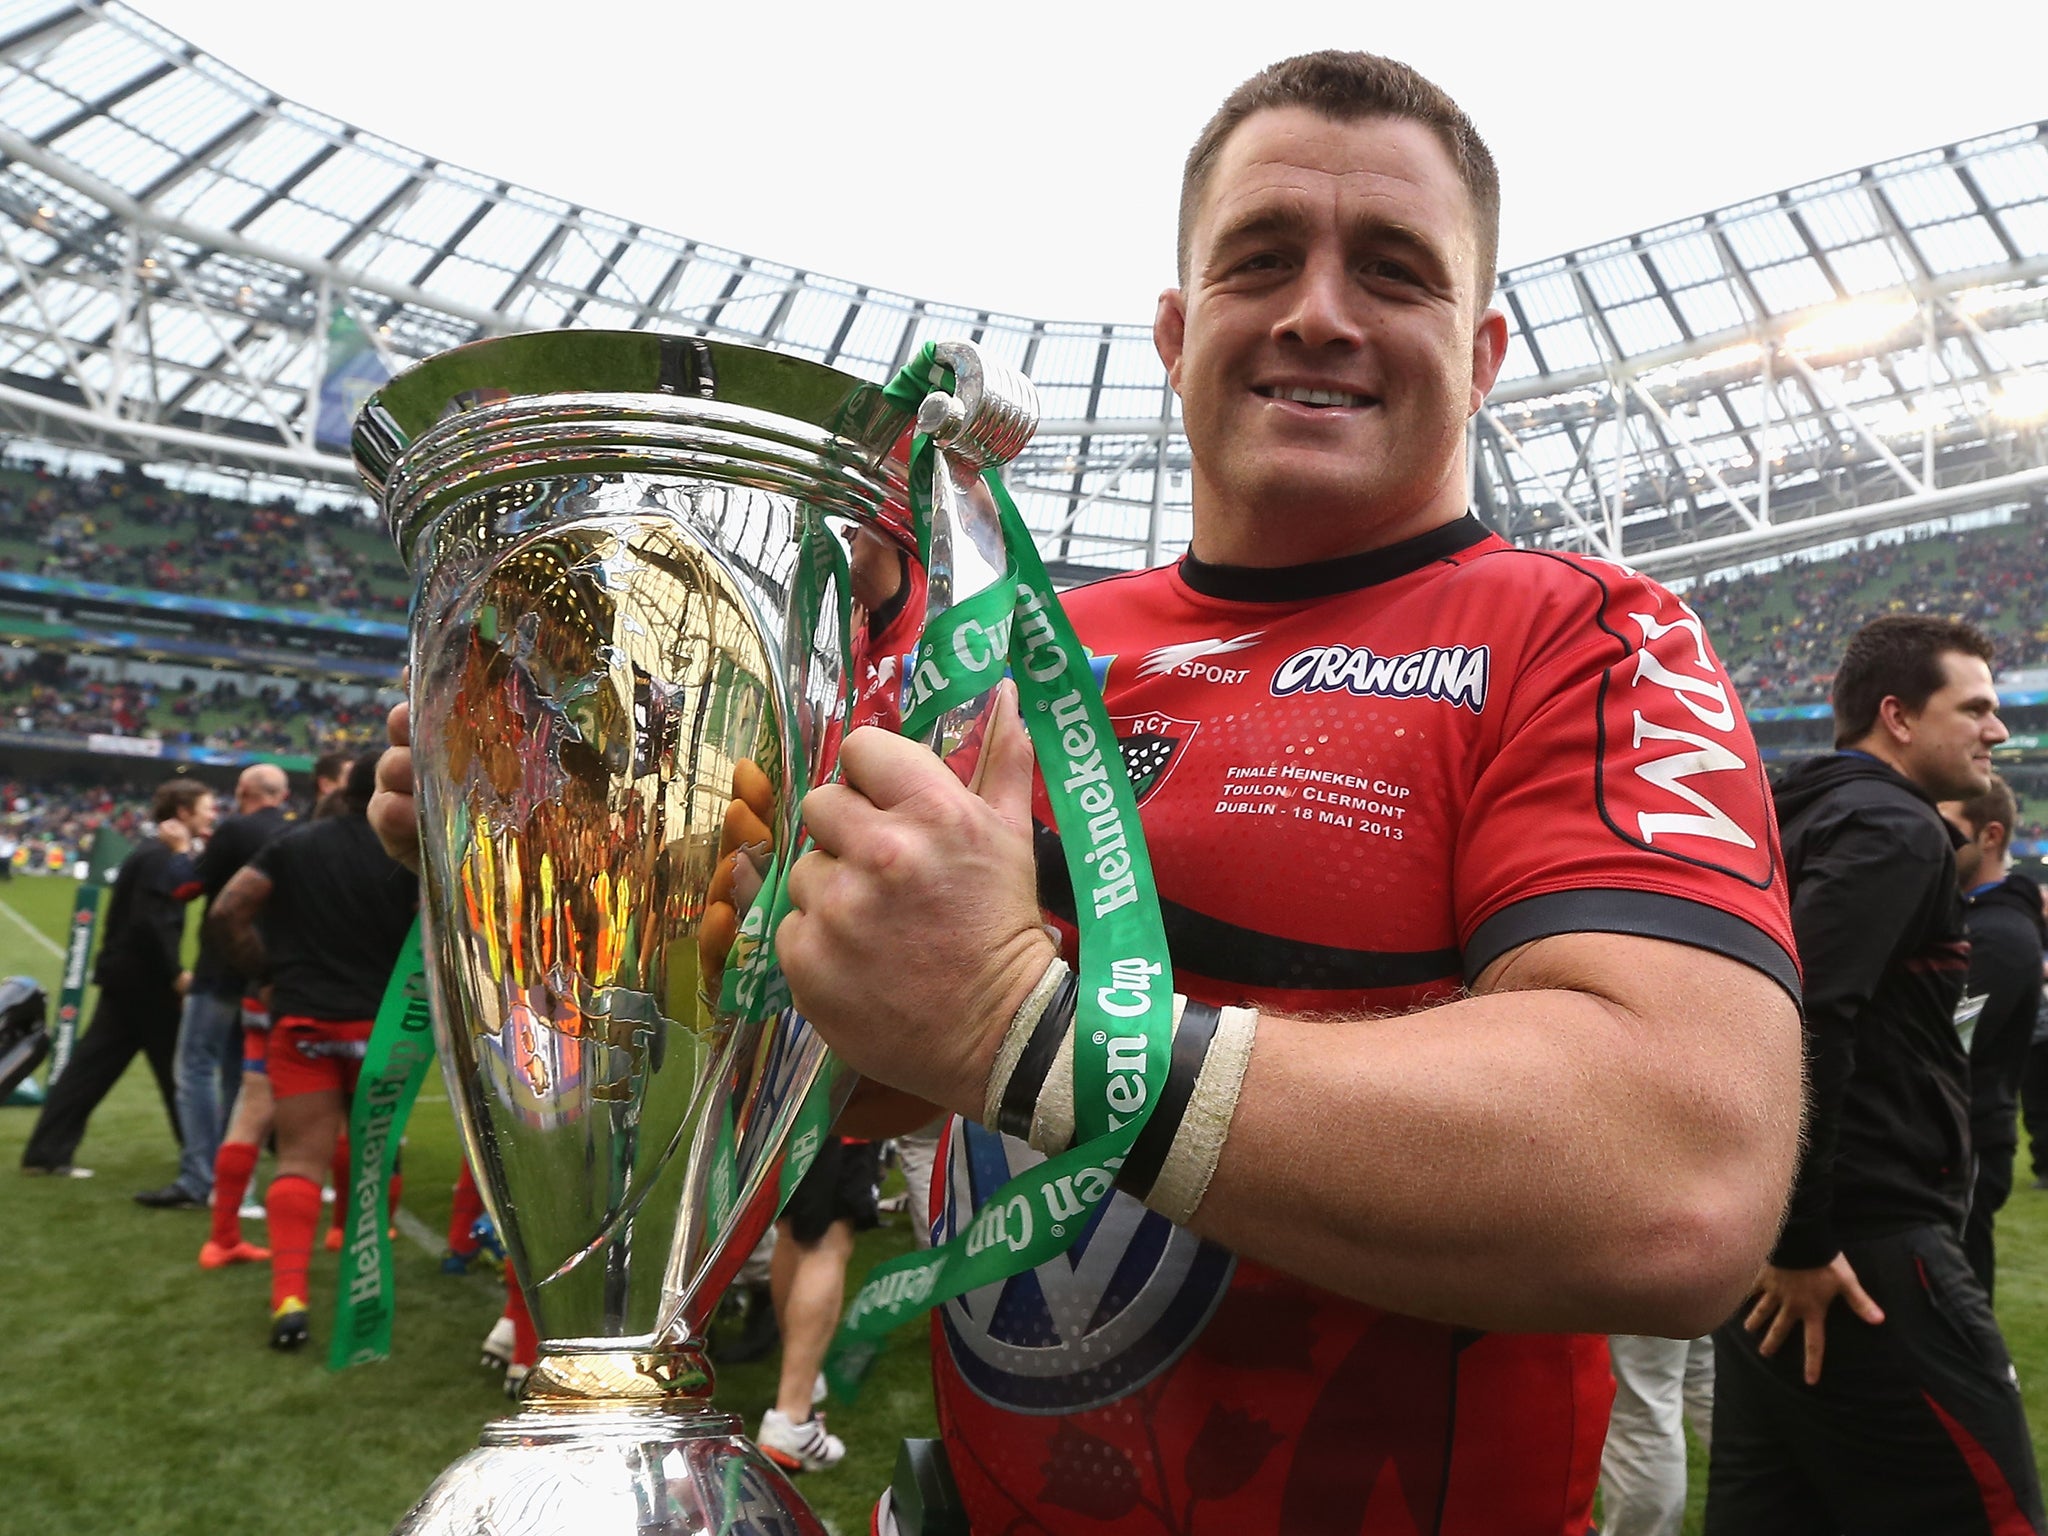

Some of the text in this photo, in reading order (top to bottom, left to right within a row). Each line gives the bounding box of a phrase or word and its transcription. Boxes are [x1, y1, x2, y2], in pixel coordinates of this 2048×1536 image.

[952, 609, 1015, 672] Cu
[1015, 583, 1069, 683] Cup
[1177, 661, 1250, 685] SPORT
[1271, 644, 1490, 714] ORANGINA
[1132, 716, 1171, 735] RCT
[1372, 779, 1411, 800] CUP
[1293, 806, 1314, 820] 18
[1318, 810, 1353, 829] MAI
[1359, 819, 1405, 840] 2013
[1097, 957, 1163, 1018] Cup
[966, 1194, 1034, 1259] Cup
